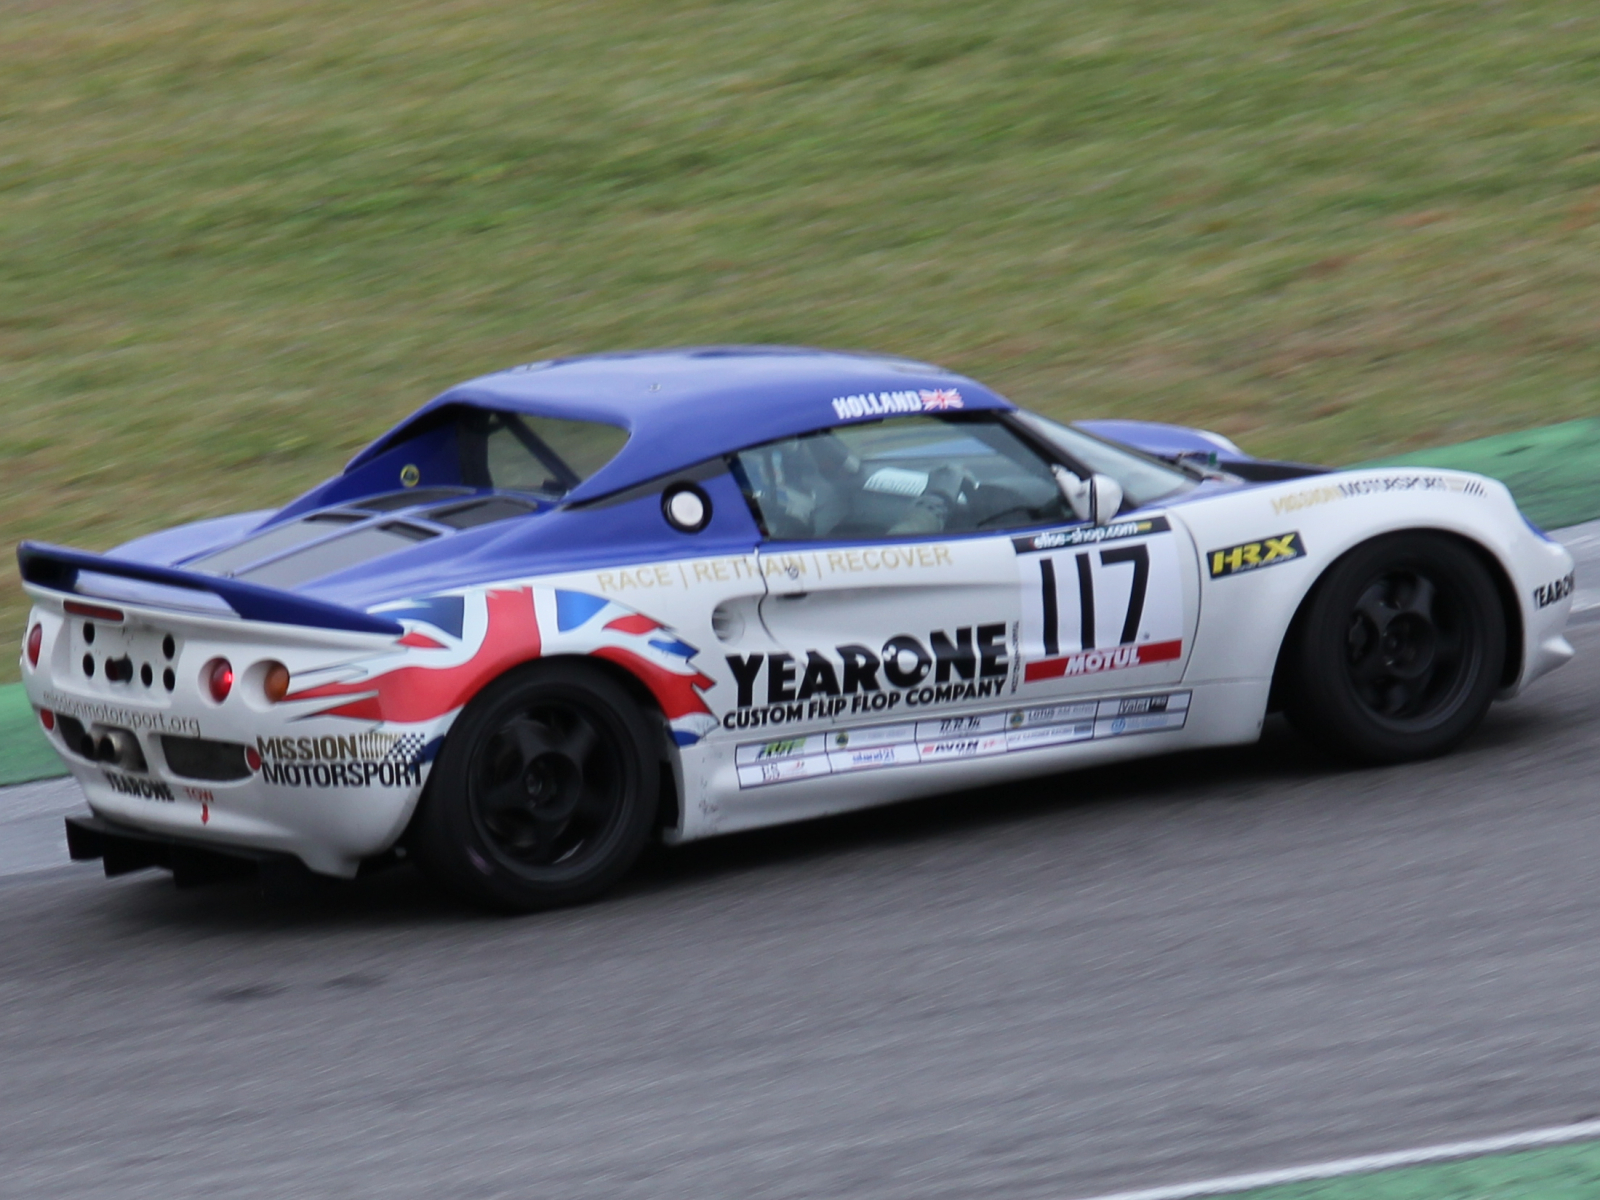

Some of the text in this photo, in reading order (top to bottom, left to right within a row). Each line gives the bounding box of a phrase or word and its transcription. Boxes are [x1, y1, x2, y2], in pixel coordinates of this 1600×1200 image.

[832, 390, 922, 420] HOLLAND
[597, 564, 673, 592] RACE
[828, 543, 953, 576] RECOVER
[1212, 533, 1296, 575] HRX
[1039, 543, 1150, 657] 117
[725, 621, 1009, 709] YEARONE
[1064, 646, 1141, 677] MOTUL
[722, 677, 1006, 731] CUSTOM FLIP FLOP COMPANY
[256, 733, 357, 760] MISSION
[261, 761, 422, 788] MOTORSPORT
